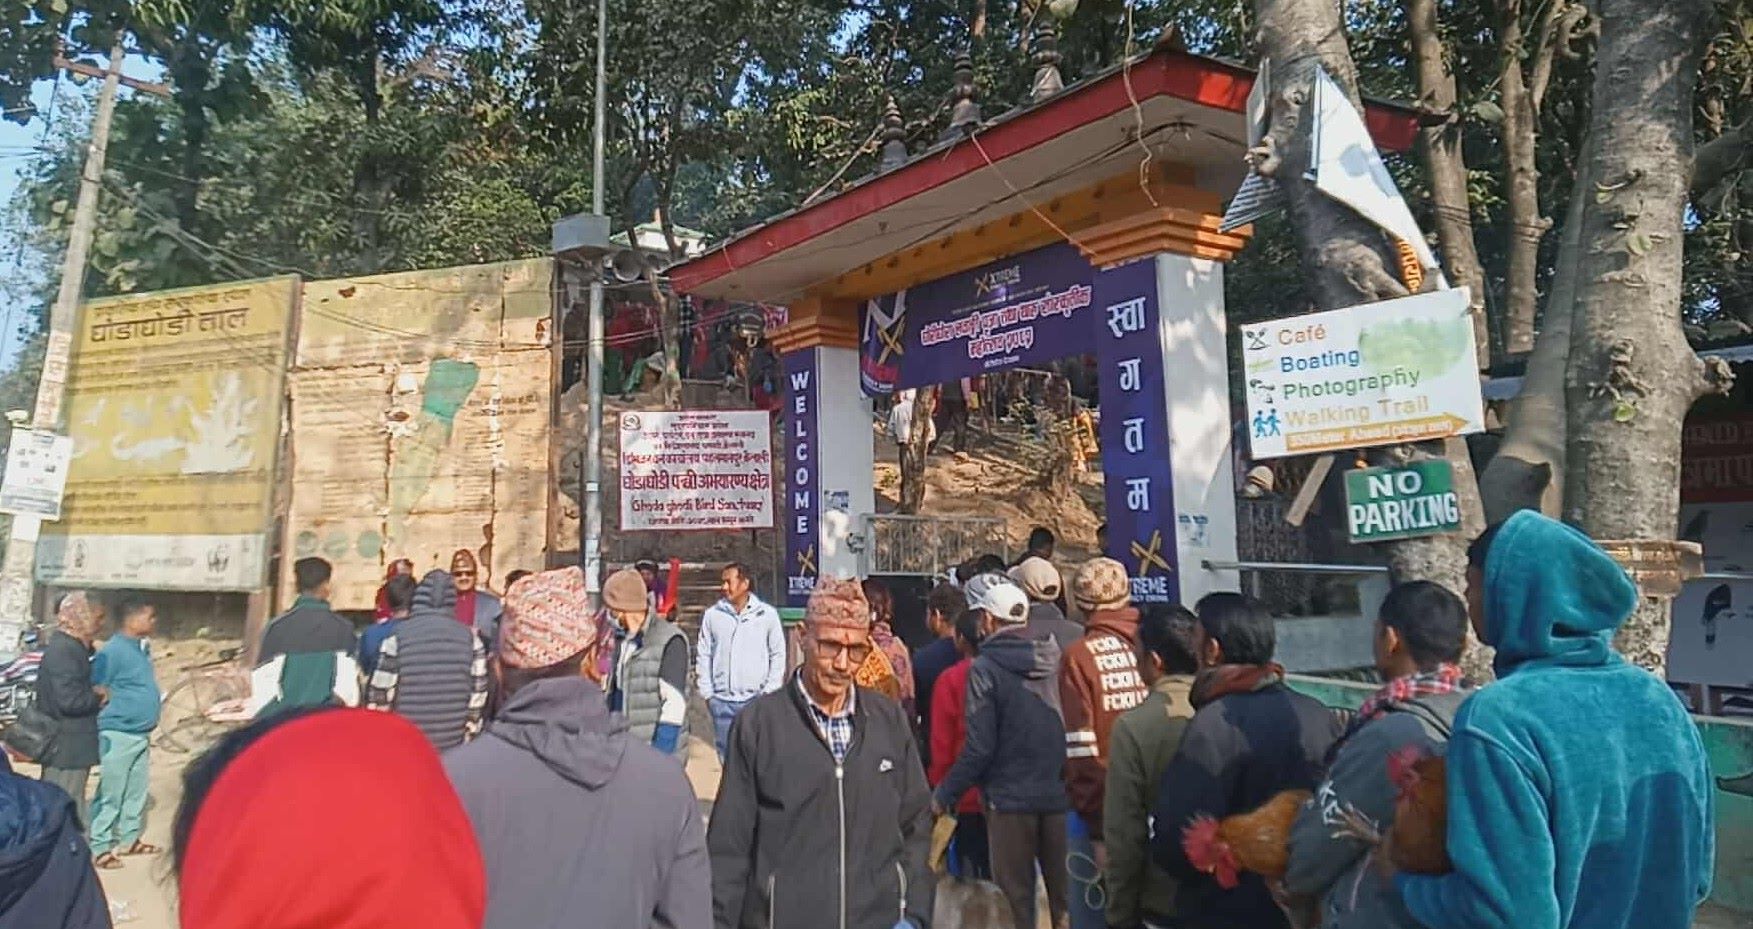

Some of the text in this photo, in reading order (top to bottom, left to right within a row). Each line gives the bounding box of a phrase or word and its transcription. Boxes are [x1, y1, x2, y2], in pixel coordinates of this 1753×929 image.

[198, 307, 250, 332] ताल
[1278, 324, 1327, 346] Café
[1280, 348, 1360, 373] Boating
[1283, 368, 1421, 400] Photography
[1284, 396, 1429, 427] Walking Trail
[790, 370, 810, 534] WELCOME
[1368, 471, 1422, 499] NO
[1350, 492, 1460, 535] PARKING
